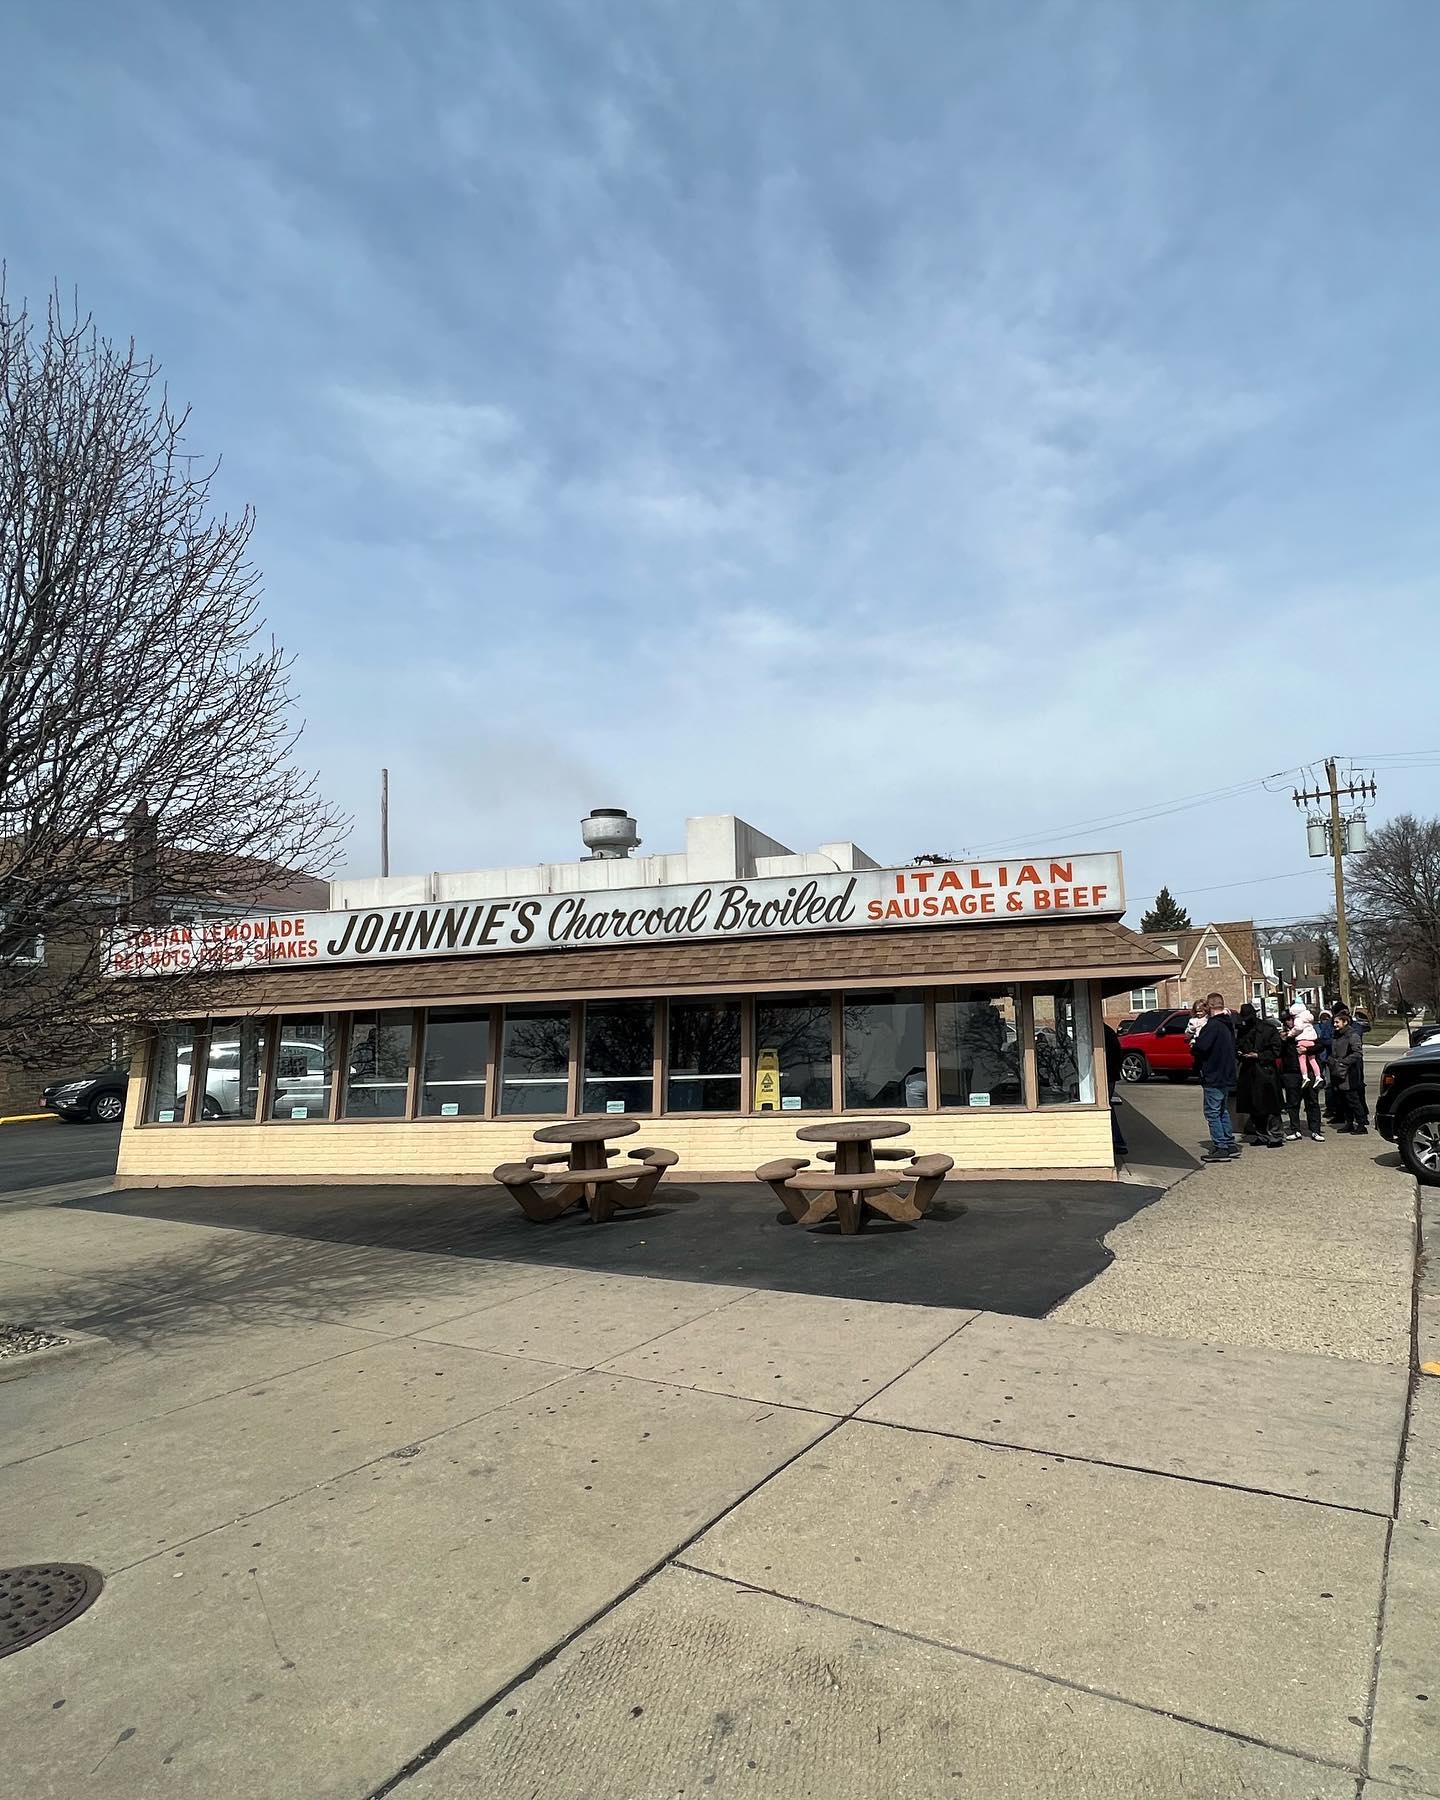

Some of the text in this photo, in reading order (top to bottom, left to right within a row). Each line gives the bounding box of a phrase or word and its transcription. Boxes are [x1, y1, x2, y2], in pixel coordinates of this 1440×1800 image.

[896, 862, 1072, 894] ITALIAN
[327, 876, 858, 956] JOHNNIE'S Charcoal Broiled
[867, 885, 1107, 920] SAUSAGE & BEEF
[127, 918, 305, 949] ALIAN LEMONADE
[254, 939, 318, 961] SHAKES
